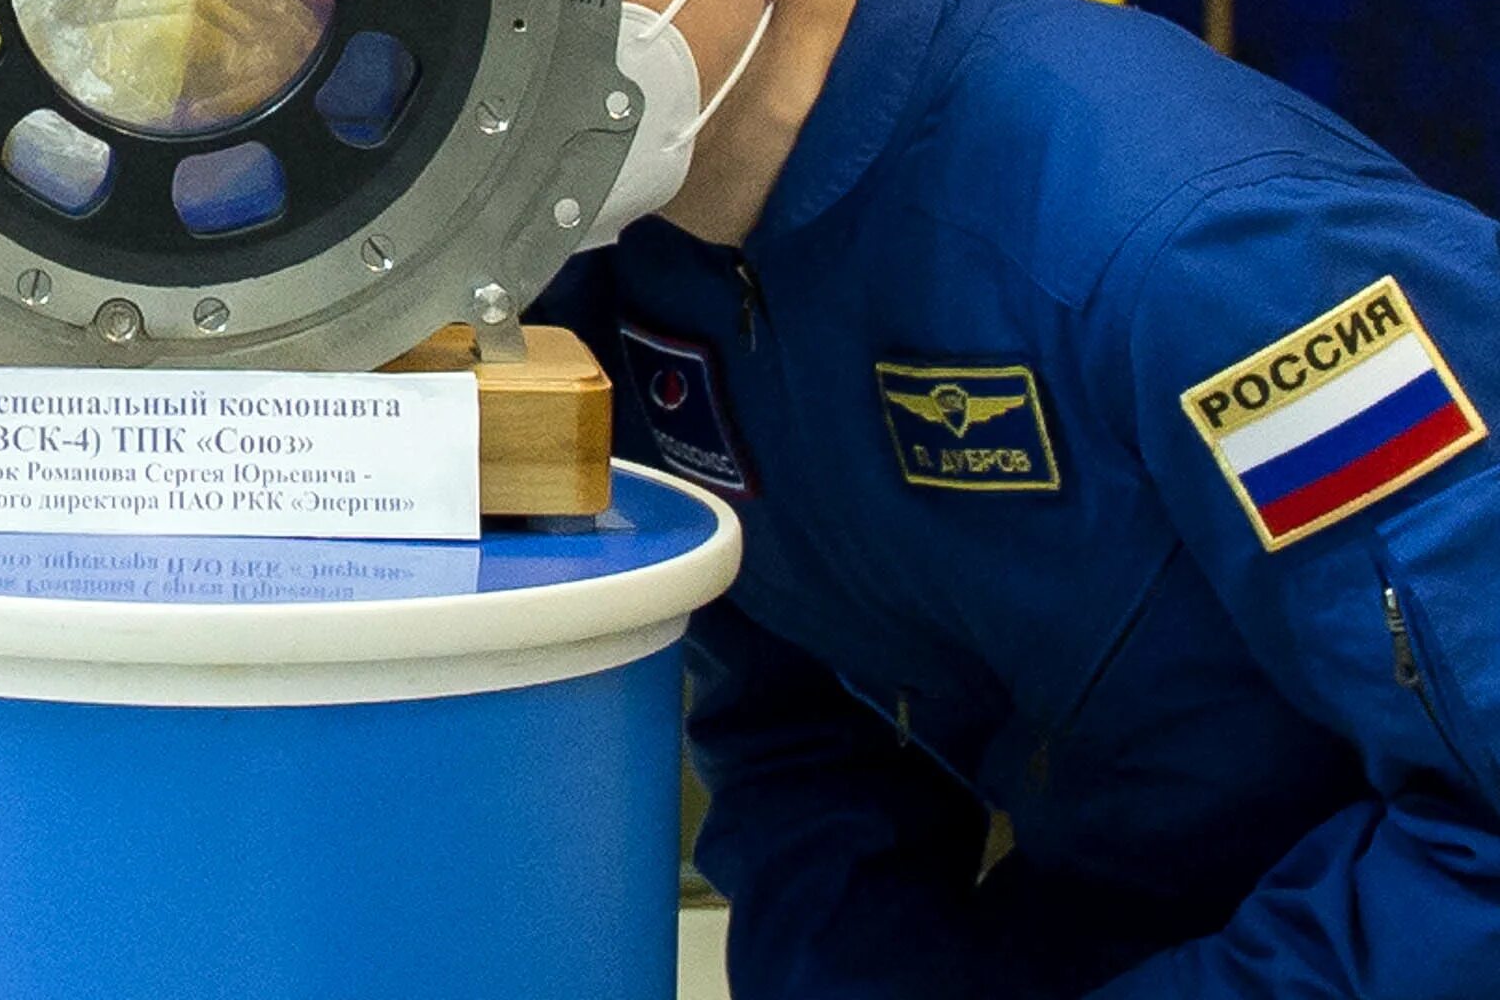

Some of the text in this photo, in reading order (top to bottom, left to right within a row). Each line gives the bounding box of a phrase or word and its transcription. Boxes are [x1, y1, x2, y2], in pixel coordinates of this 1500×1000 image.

[1198, 295, 1404, 428] РОССИЯ
[220, 398, 401, 418] космонавта
[112, 427, 187, 453] ТПК
[197, 427, 314, 454] «Союз»
[941, 449, 1032, 473] ДУБРОВ
[28, 462, 137, 482] Романова
[145, 462, 224, 488] Сергея
[234, 463, 356, 488] Юрьевича
[39, 492, 159, 515] директора
[169, 491, 223, 512] ПАО
[233, 491, 284, 512] РКК
[291, 491, 416, 516] «Энергия»
